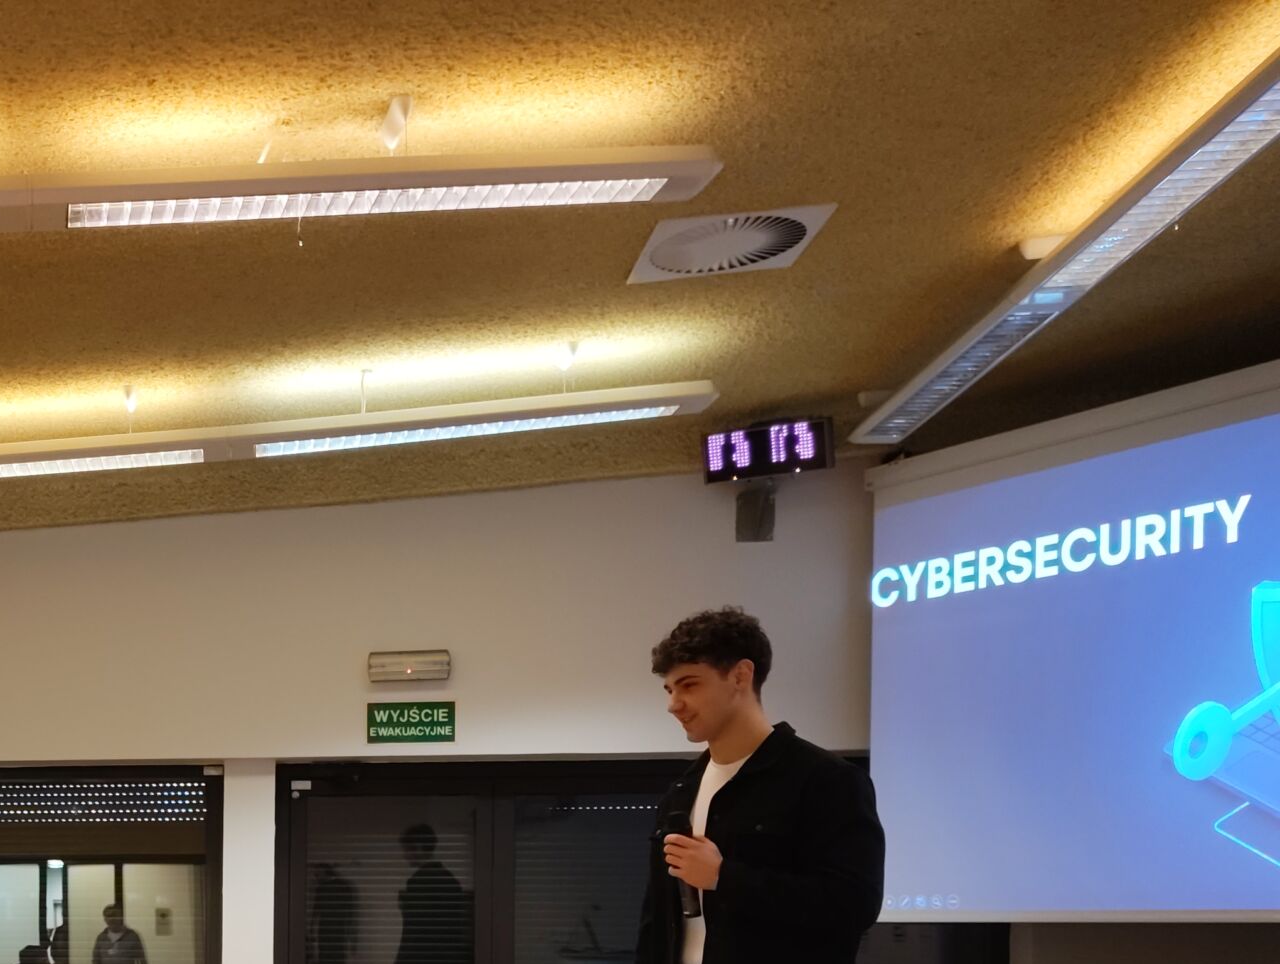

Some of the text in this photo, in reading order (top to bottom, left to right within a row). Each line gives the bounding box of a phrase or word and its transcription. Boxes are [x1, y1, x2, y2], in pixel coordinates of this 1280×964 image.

[871, 494, 1252, 609] CYBERSECURITY
[374, 706, 449, 722] WYJŚCIE
[369, 726, 453, 737] EWAKUACYJNE
